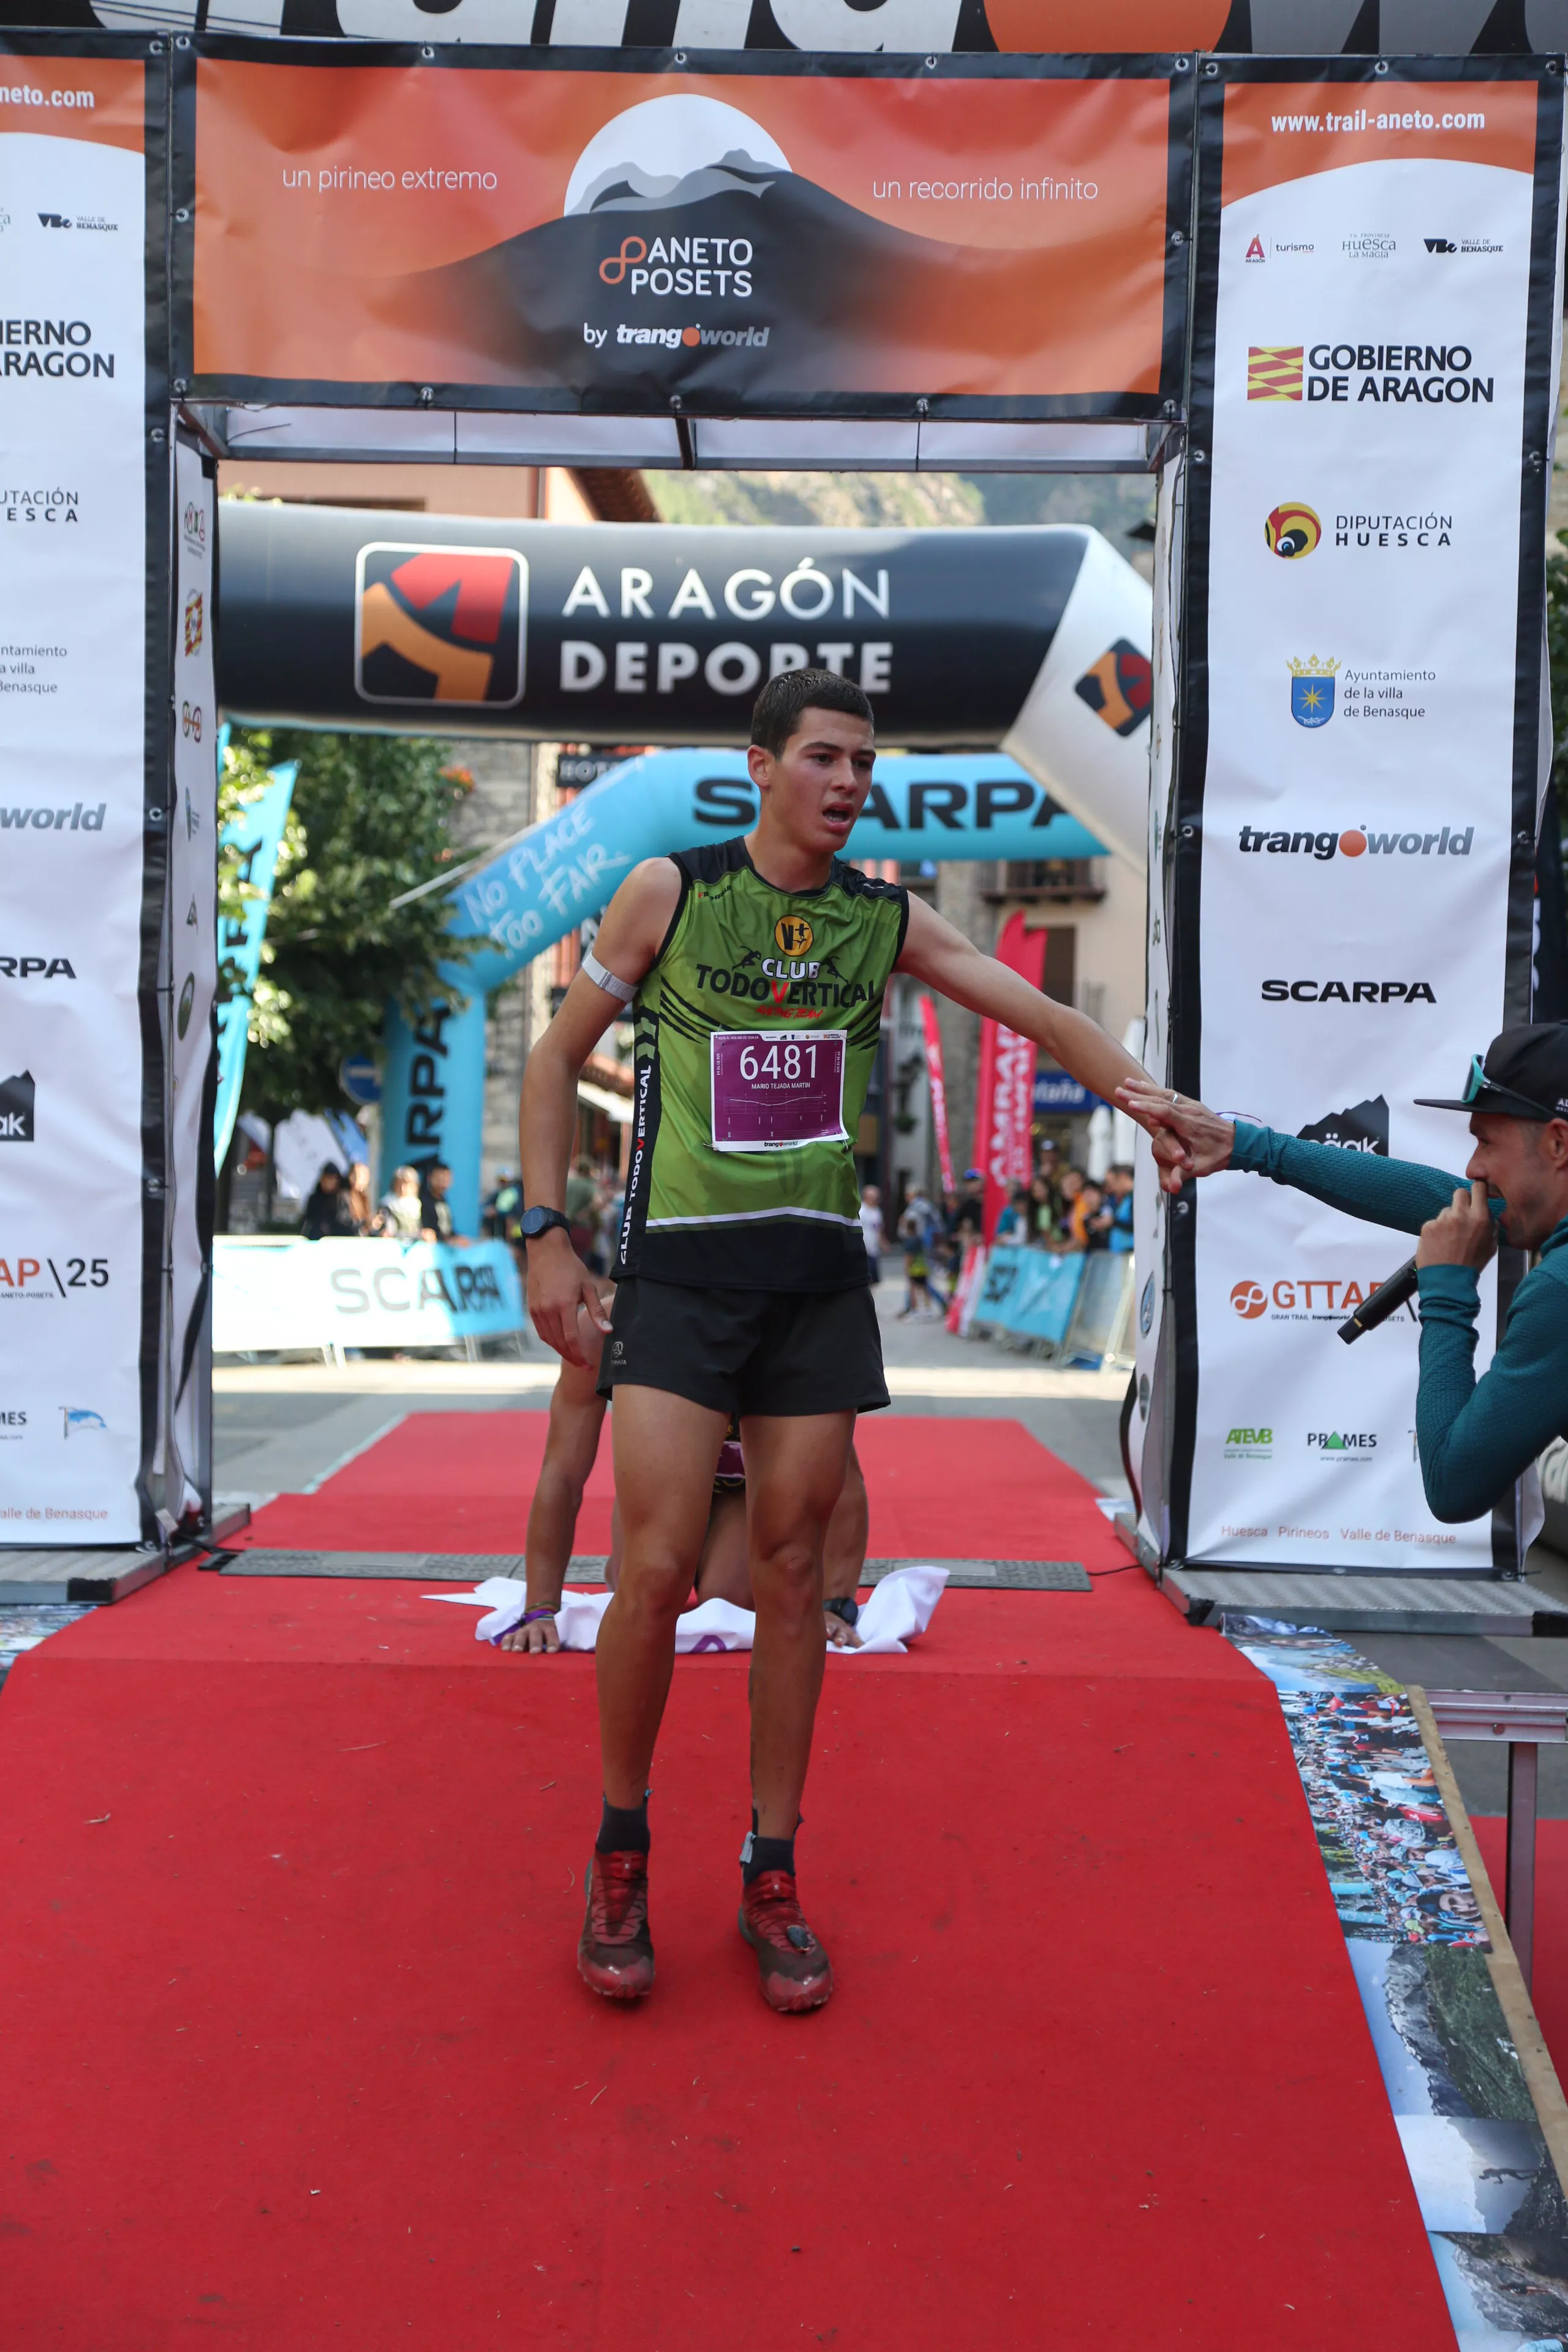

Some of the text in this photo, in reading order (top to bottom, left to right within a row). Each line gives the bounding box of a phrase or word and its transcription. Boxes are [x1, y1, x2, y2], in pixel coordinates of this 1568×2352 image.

[1272, 109, 1485, 132] www.trail-aneto.com
[283, 166, 497, 193] un pirineo extremo
[873, 177, 1098, 200] un recorrido infinito
[647, 237, 753, 266] ANETO
[1276, 243, 1314, 252] turismo
[631, 268, 752, 297] POSETS
[583, 323, 608, 349] by
[0, 351, 115, 378] RAGON
[1308, 344, 1472, 371] GOBIERNO
[1307, 376, 1494, 402] DE ARAGON
[1336, 512, 1452, 530] DIPUTACIÓN
[1335, 532, 1451, 546] HUESCA
[562, 556, 889, 621] ARAGÓN
[10, 662, 34, 674] villa
[560, 640, 892, 697] DEPORTE
[1344, 669, 1436, 684] Ayuntamiento
[1344, 687, 1403, 699] de la villa
[1343, 705, 1425, 720] de Benasque
[463, 803, 595, 927] NO PLACE
[489, 910, 544, 960] TOO
[538, 843, 635, 917] FAR
[761, 957, 821, 980] CLUB
[696, 963, 876, 1009] TODOVERTICAL
[1261, 979, 1437, 1004] SCARPA
[740, 1044, 816, 1080] 6481
[620, 1065, 652, 1264] CLUB TODOVERTICAL
[26, 1507, 41, 1520] de
[45, 1507, 108, 1521] Benasque
[1221, 1525, 1457, 1545] Huesca Pirineos Valle de Benasque
